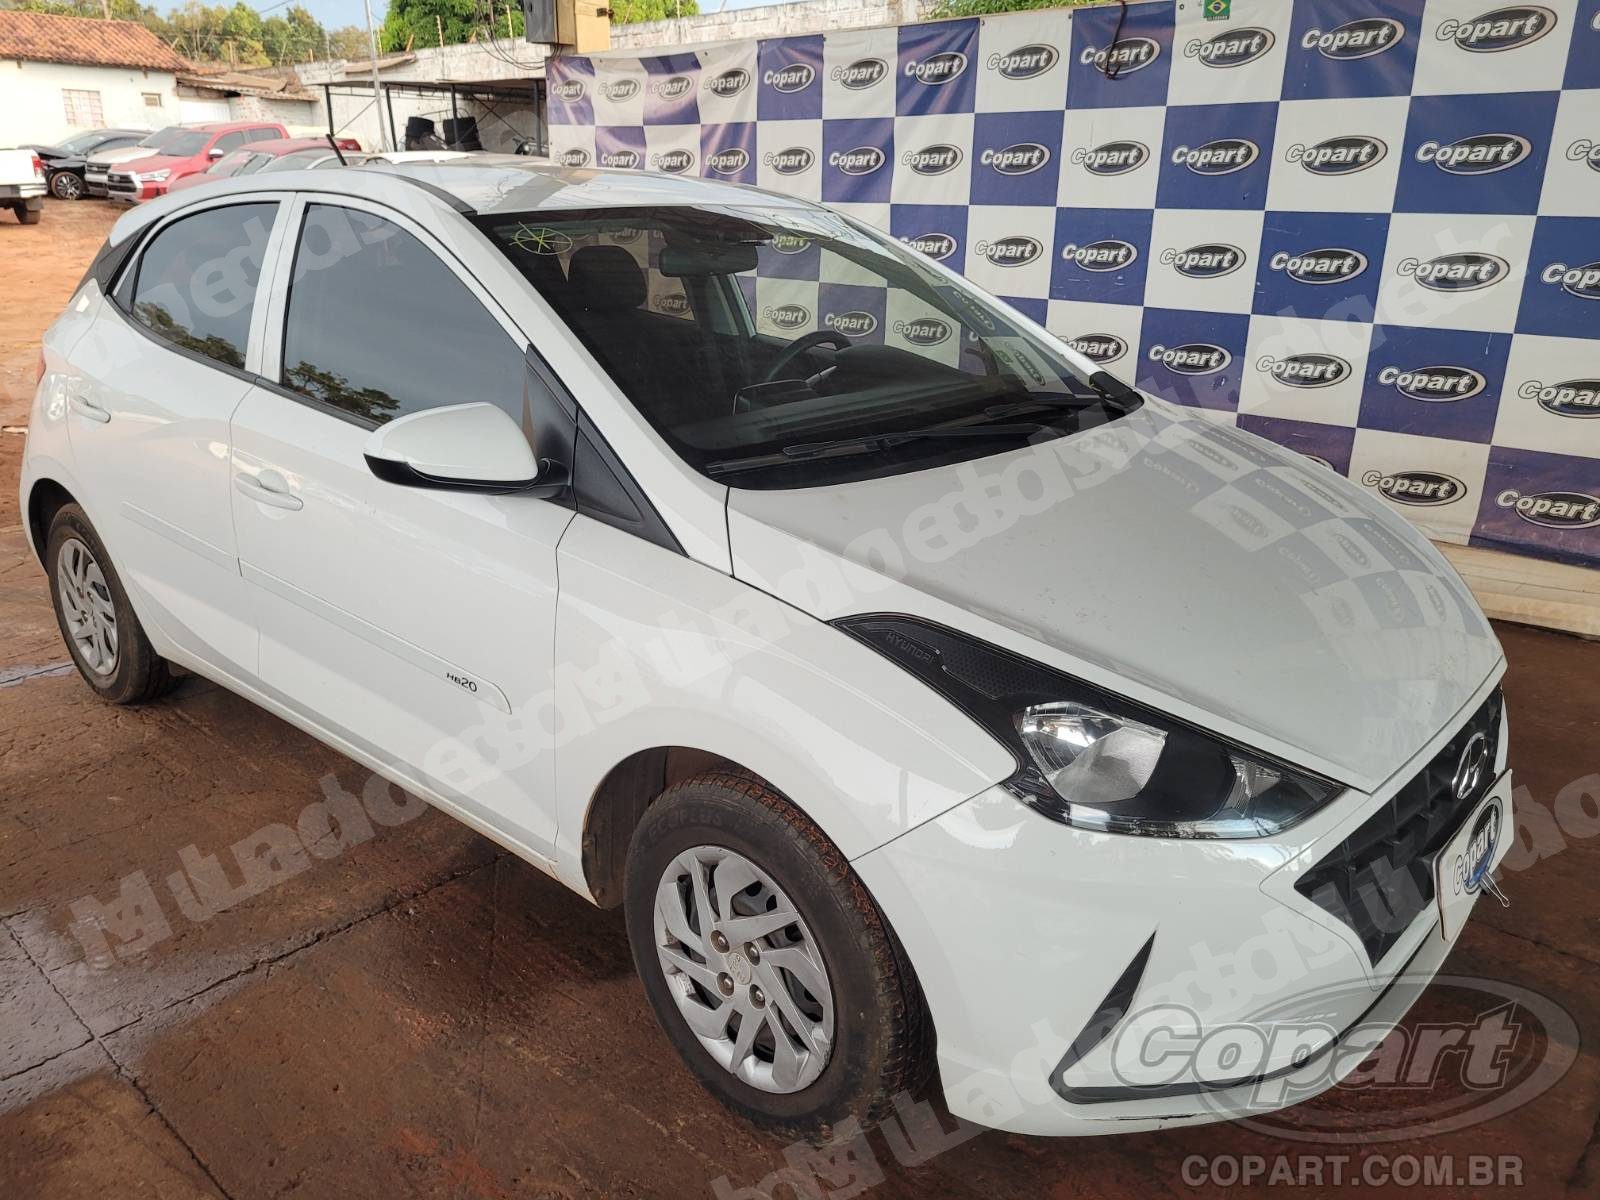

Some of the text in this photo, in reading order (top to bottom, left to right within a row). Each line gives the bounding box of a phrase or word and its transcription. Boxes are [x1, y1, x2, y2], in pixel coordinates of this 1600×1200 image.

[1302, 24, 1394, 53] Copart
[1435, 13, 1542, 46] Copart
[1080, 44, 1151, 69] Copart
[1183, 35, 1263, 59] Copart
[831, 61, 881, 83] Copart
[904, 58, 960, 80] Copart
[986, 50, 1049, 74] Copart
[651, 78, 688, 97] Copart
[704, 72, 745, 92] Copart
[764, 67, 809, 86] Copart
[552, 80, 583, 97] Copart
[598, 80, 634, 98] Copart
[601, 151, 635, 169] Copart
[651, 152, 688, 170] Copart
[704, 151, 746, 170] Copart
[764, 151, 809, 170] Copart
[829, 152, 878, 170] Copart
[901, 150, 953, 171] Copart
[980, 149, 1041, 168] Copart
[1070, 147, 1139, 168] Copart
[1171, 144, 1250, 168] Copart
[1285, 143, 1374, 168] Copart
[1415, 139, 1519, 168] Copart
[975, 239, 1034, 262] Copart
[1062, 244, 1128, 267] Copart
[1159, 248, 1234, 272] Copart
[1269, 251, 1357, 279] Copart
[1396, 257, 1496, 283] Copart
[1540, 262, 1600, 290] Cop
[763, 305, 804, 325] Copart
[825, 312, 872, 332] Copart
[893, 319, 945, 341] Copart
[1148, 344, 1223, 369] Copart
[1256, 355, 1338, 381] Copart
[1378, 366, 1473, 395] Copart
[1362, 471, 1453, 499] Copart
[1495, 489, 1600, 522] Copart
[446, 672, 478, 693] HB20
[1453, 804, 1497, 896] Copart
